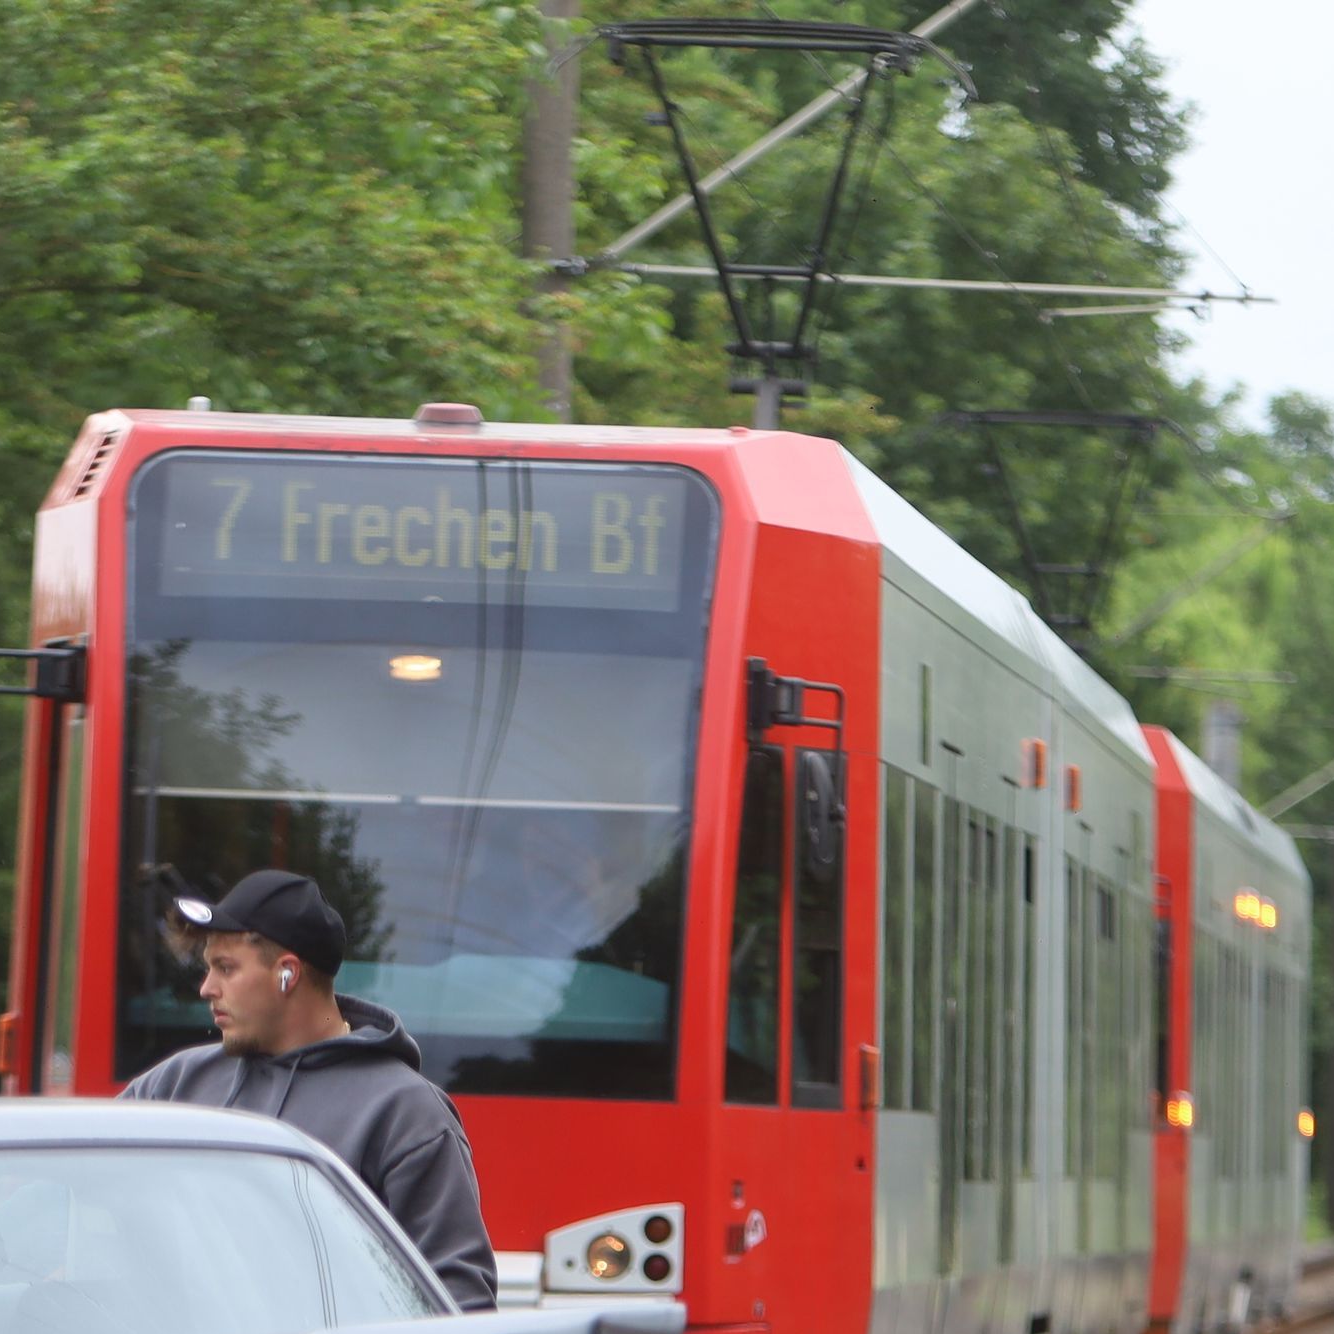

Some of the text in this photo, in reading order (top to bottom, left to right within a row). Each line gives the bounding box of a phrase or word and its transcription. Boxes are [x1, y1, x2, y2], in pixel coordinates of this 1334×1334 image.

[212, 477, 665, 576] 7 Frechen Bf
